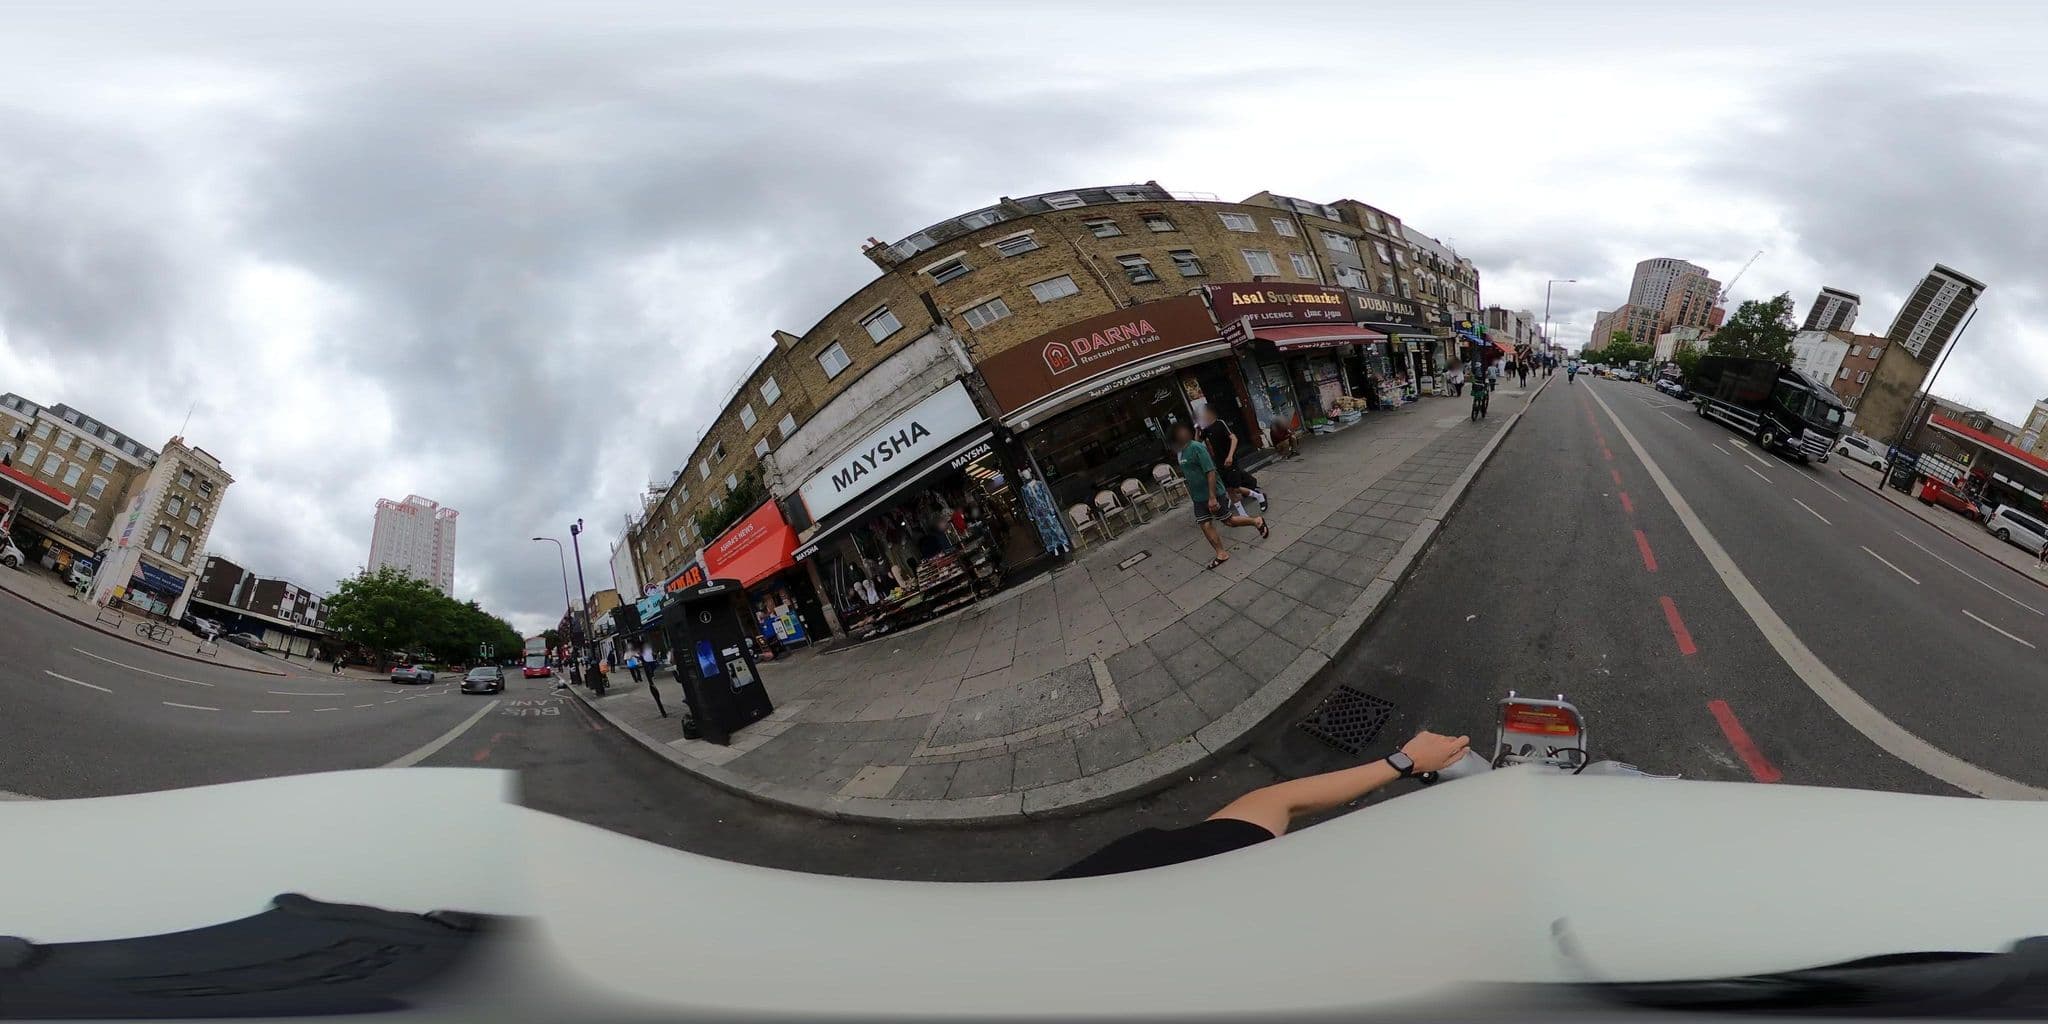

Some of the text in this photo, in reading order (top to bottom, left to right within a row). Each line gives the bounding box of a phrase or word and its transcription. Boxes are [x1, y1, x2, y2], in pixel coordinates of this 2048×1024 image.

[1232, 291, 1341, 306] Asal Supermarket
[1358, 297, 1415, 315] DUBAI MALL
[1261, 311, 1294, 320] LICENCE
[1071, 320, 1156, 356] DARNA
[1080, 343, 1130, 364] Restaurant
[831, 421, 931, 493] MAYSHA
[951, 443, 991, 469] MAYSHA
[796, 545, 819, 561] MAYSHA
